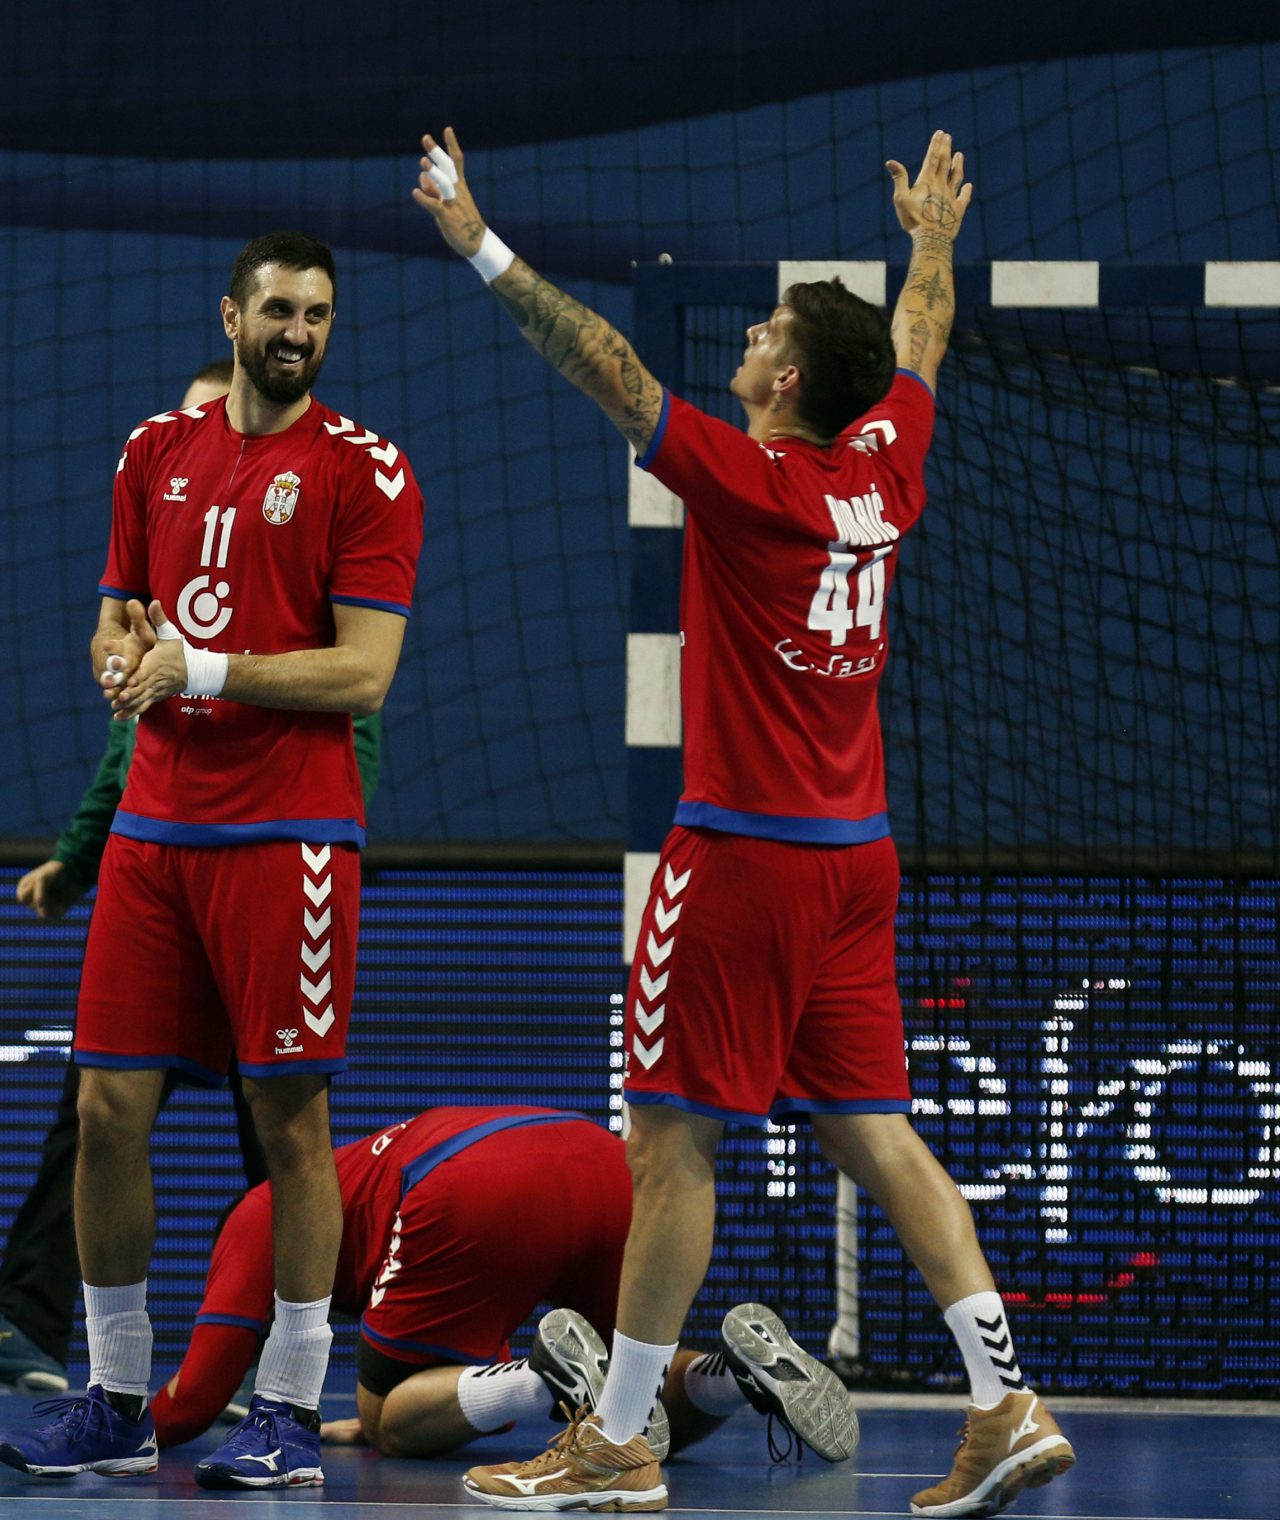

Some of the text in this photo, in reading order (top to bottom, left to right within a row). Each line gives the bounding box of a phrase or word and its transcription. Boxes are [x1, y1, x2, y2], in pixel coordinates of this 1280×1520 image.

[200, 505, 236, 568] 11
[807, 545, 894, 646] 44
[181, 706, 194, 715] otp
